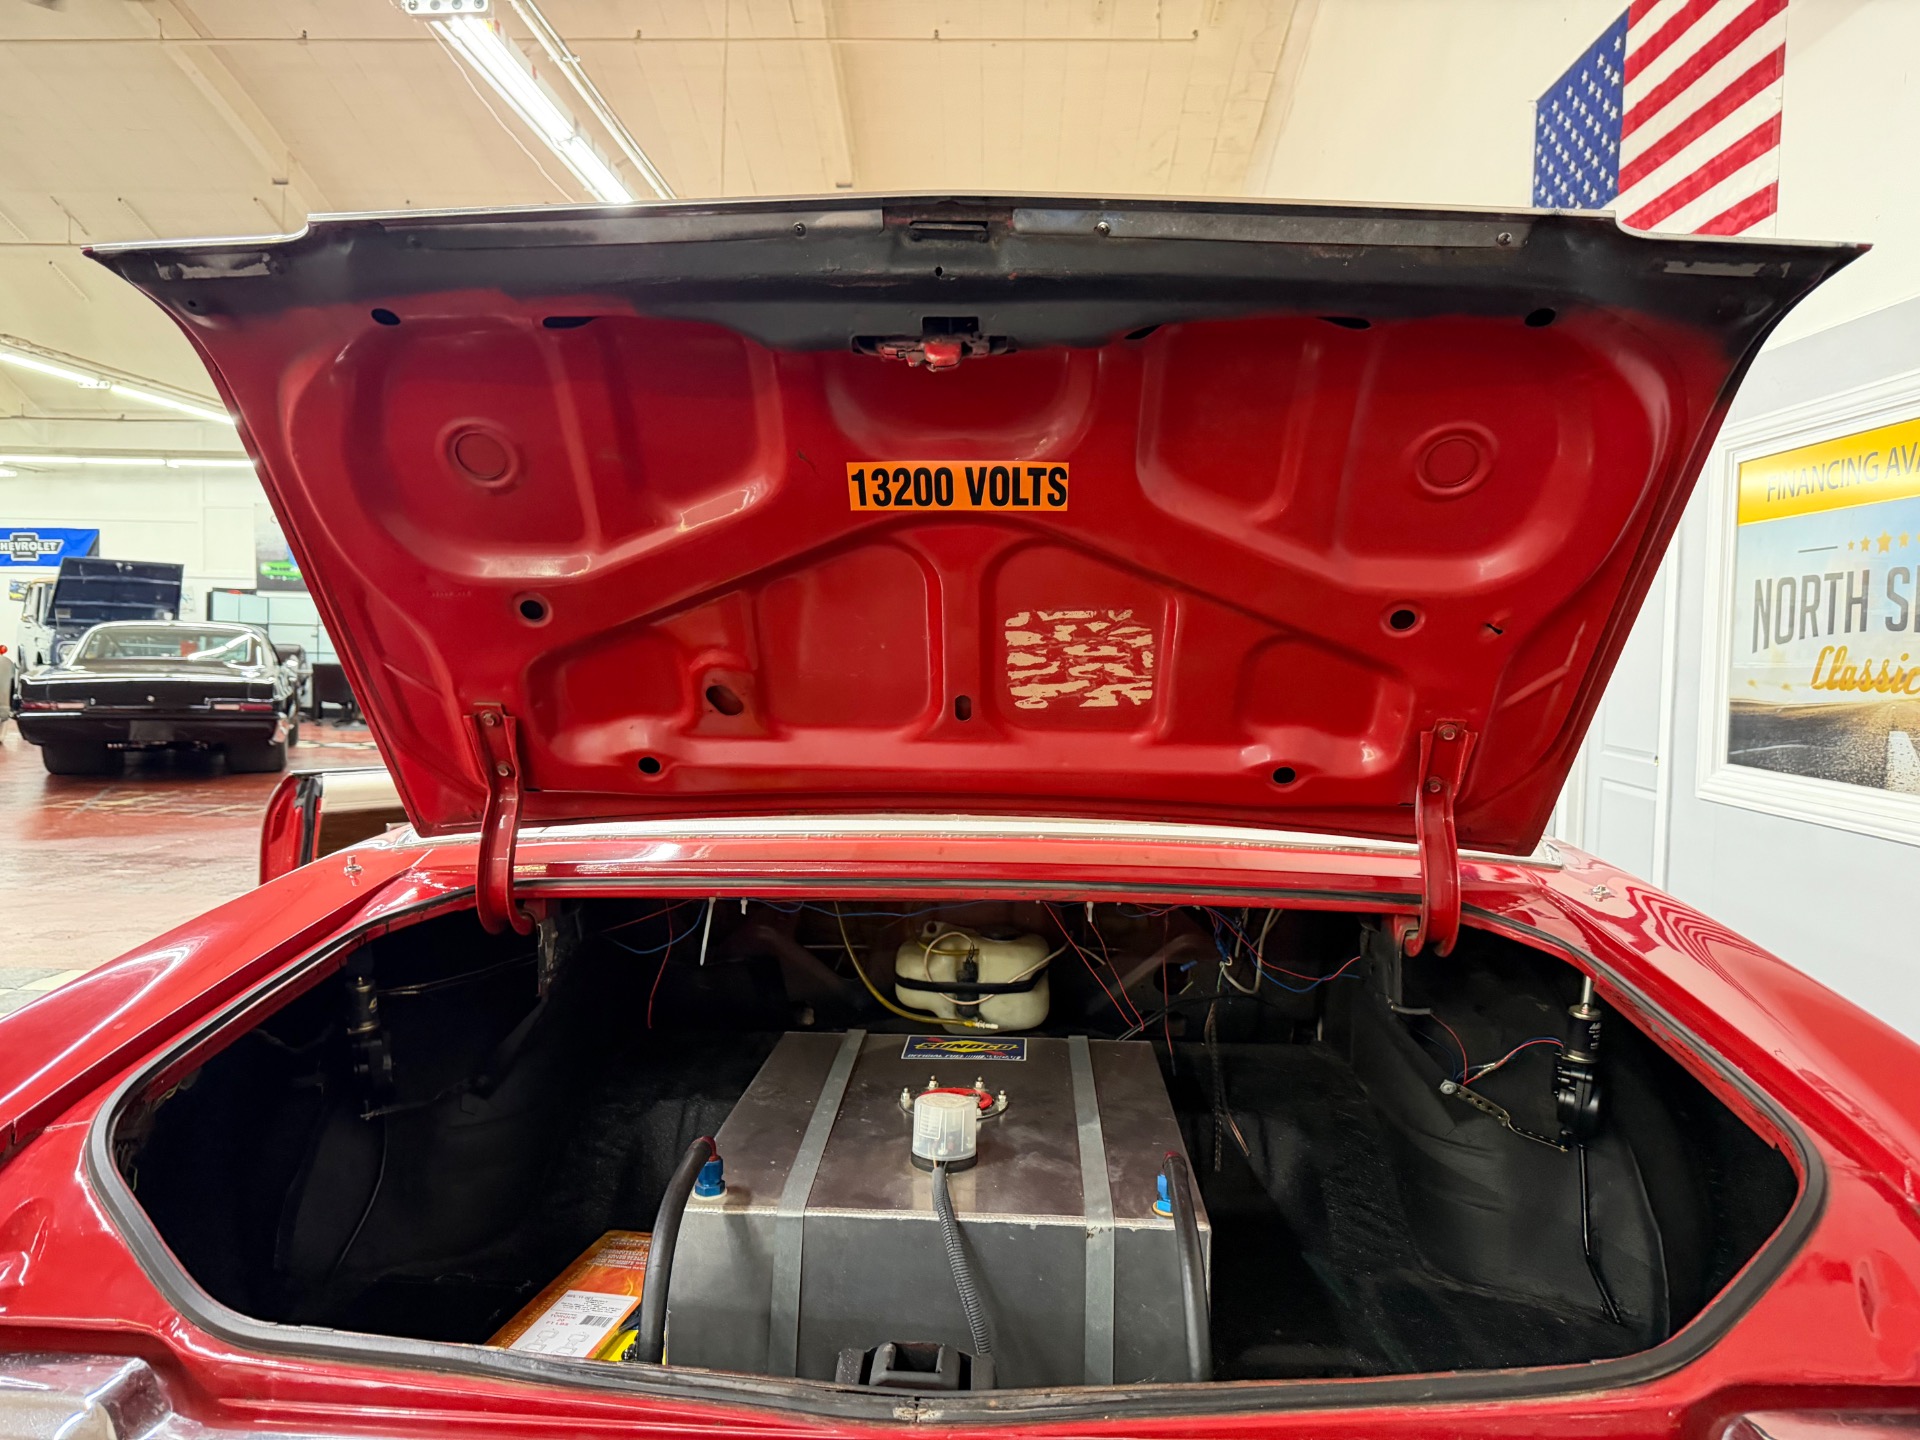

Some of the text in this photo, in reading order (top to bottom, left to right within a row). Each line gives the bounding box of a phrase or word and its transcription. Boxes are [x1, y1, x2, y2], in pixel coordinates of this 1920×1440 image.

[851, 465, 1068, 507] 13200 VOLTS
[1767, 442, 1920, 502] FINANCING AV
[0, 541, 57, 552] HEVROLET
[1752, 568, 1870, 655] NORTH
[919, 1042, 1014, 1051] SUNOCO
